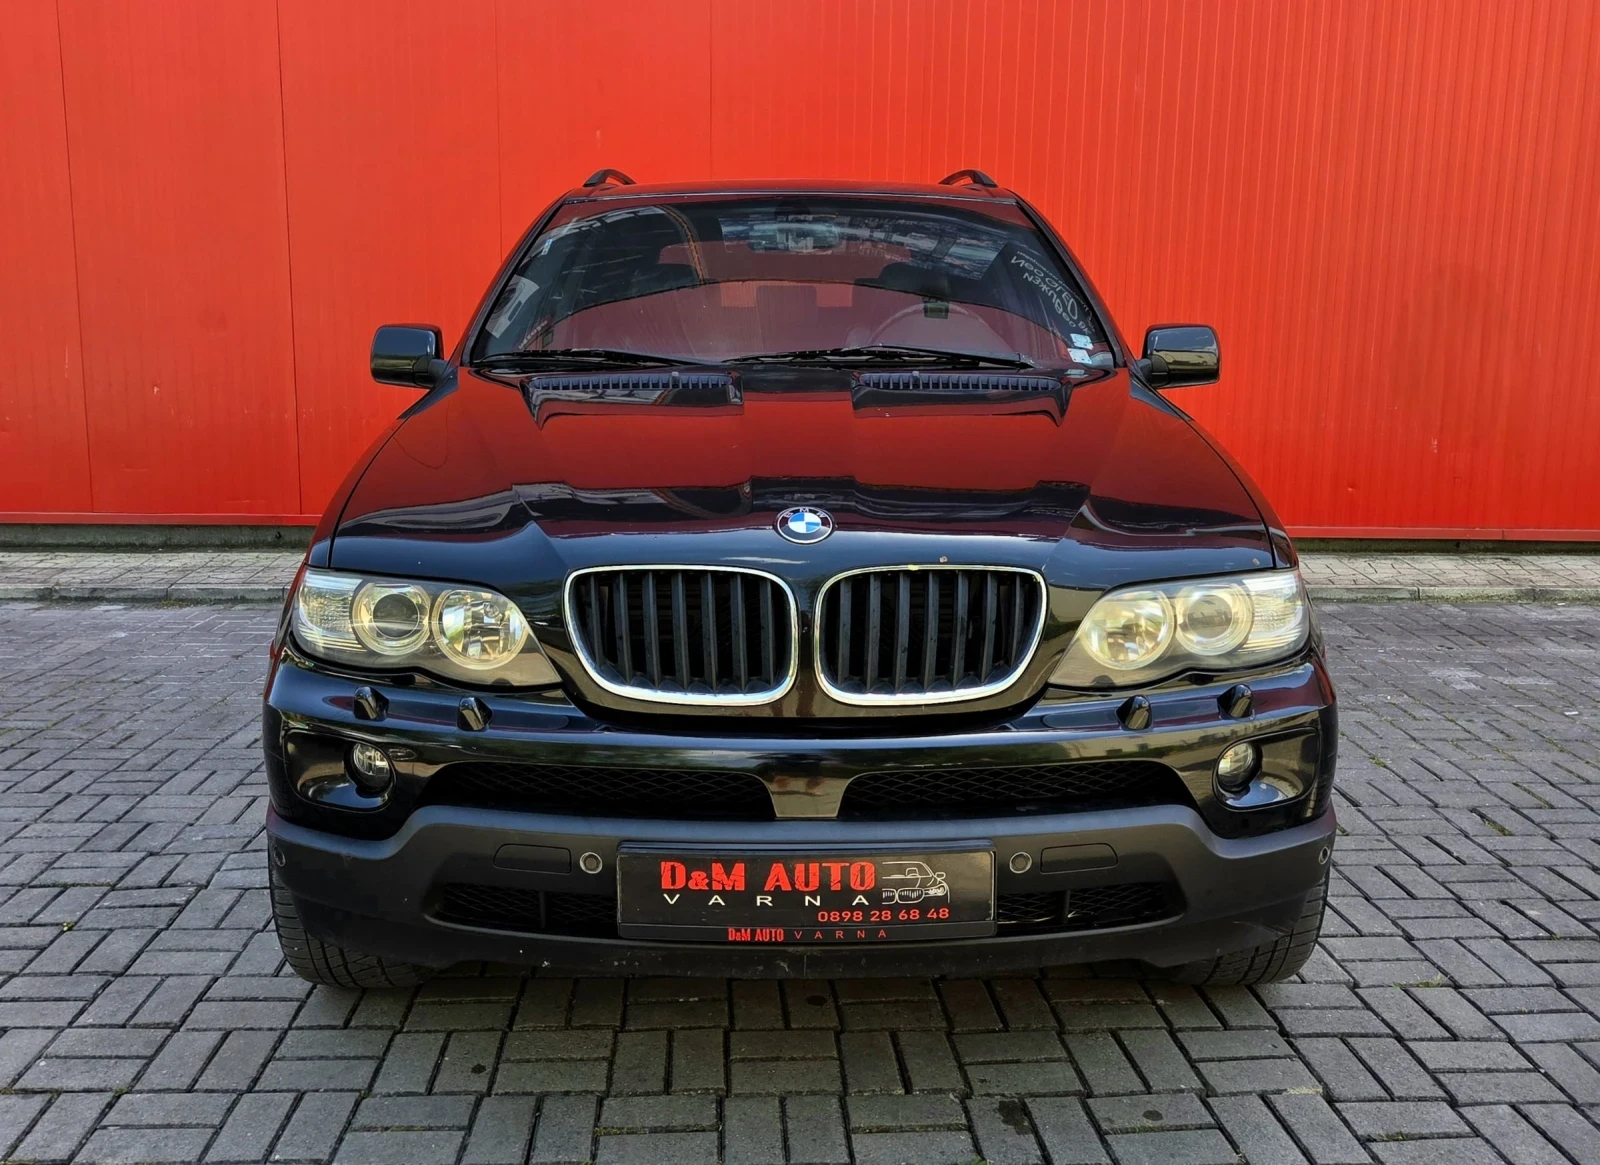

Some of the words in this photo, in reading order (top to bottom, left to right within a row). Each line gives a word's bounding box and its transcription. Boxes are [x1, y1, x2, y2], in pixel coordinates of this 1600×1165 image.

[661, 861, 745, 891] D&M
[764, 860, 876, 891] AUTO
[663, 893, 868, 907] VARNA
[817, 911, 864, 922] 0898
[870, 910, 892, 922] 28
[898, 908, 920, 921] 68
[926, 908, 950, 919] 48
[727, 928, 751, 941] D&M
[754, 928, 785, 942] AUTO
[795, 929, 886, 939] VARNA
